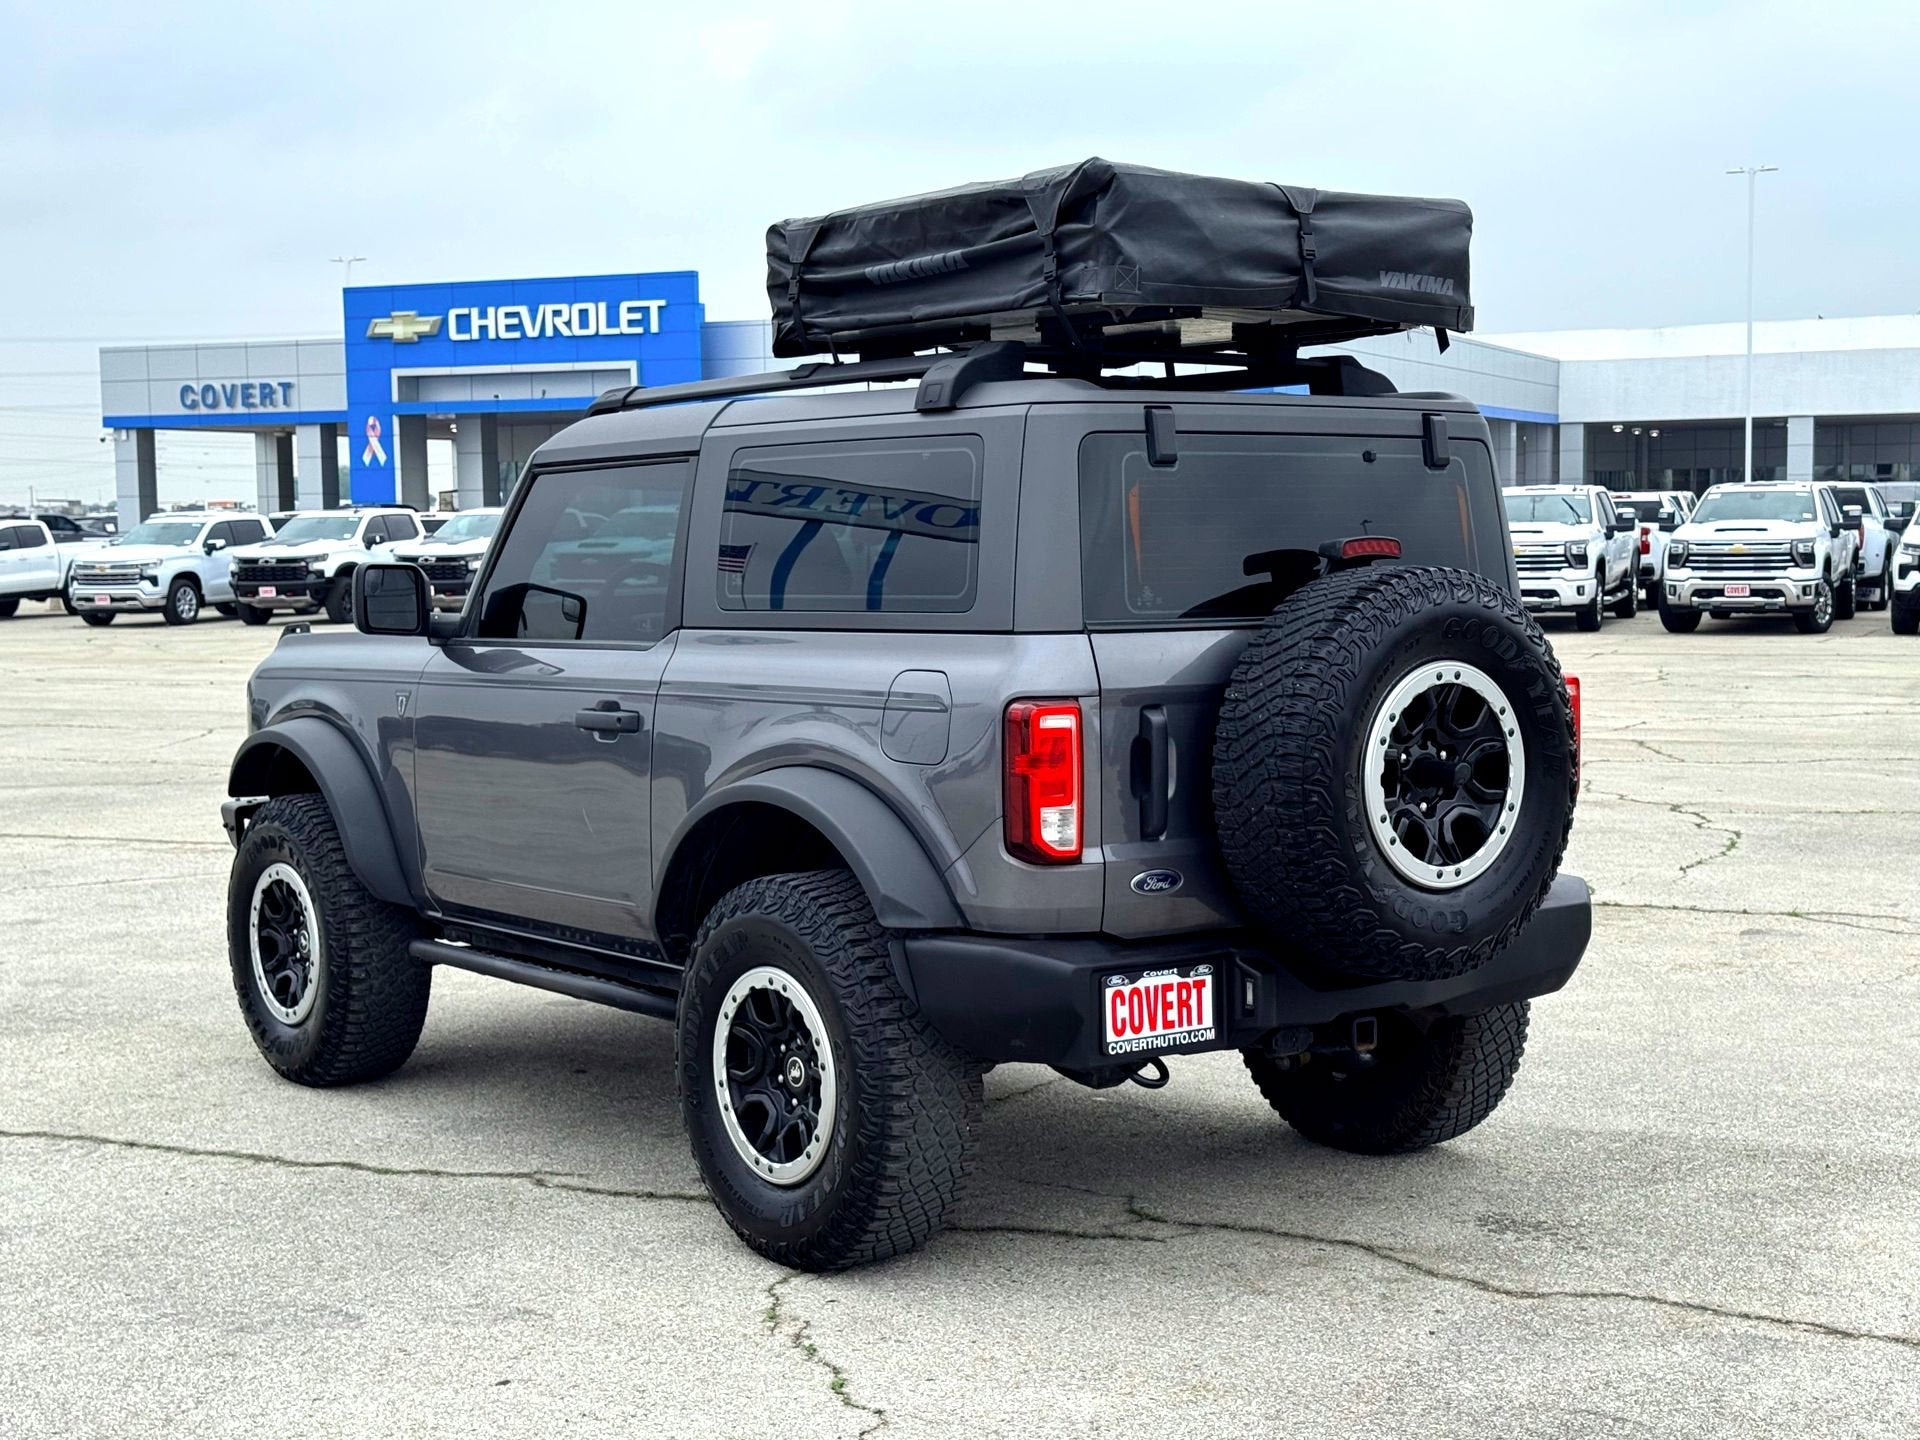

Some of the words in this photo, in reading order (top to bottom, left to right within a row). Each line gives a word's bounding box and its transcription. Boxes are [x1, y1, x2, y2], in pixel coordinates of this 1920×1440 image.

[1380, 270, 1455, 296] YAKIMA
[448, 299, 667, 341] CHEVROLET
[180, 382, 295, 410] COVERT
[1143, 874, 1172, 890] Ford
[1143, 968, 1178, 978] Covert
[1111, 979, 1206, 1037] COVERT
[1108, 1028, 1215, 1055] COVERTHUTTO.COM
